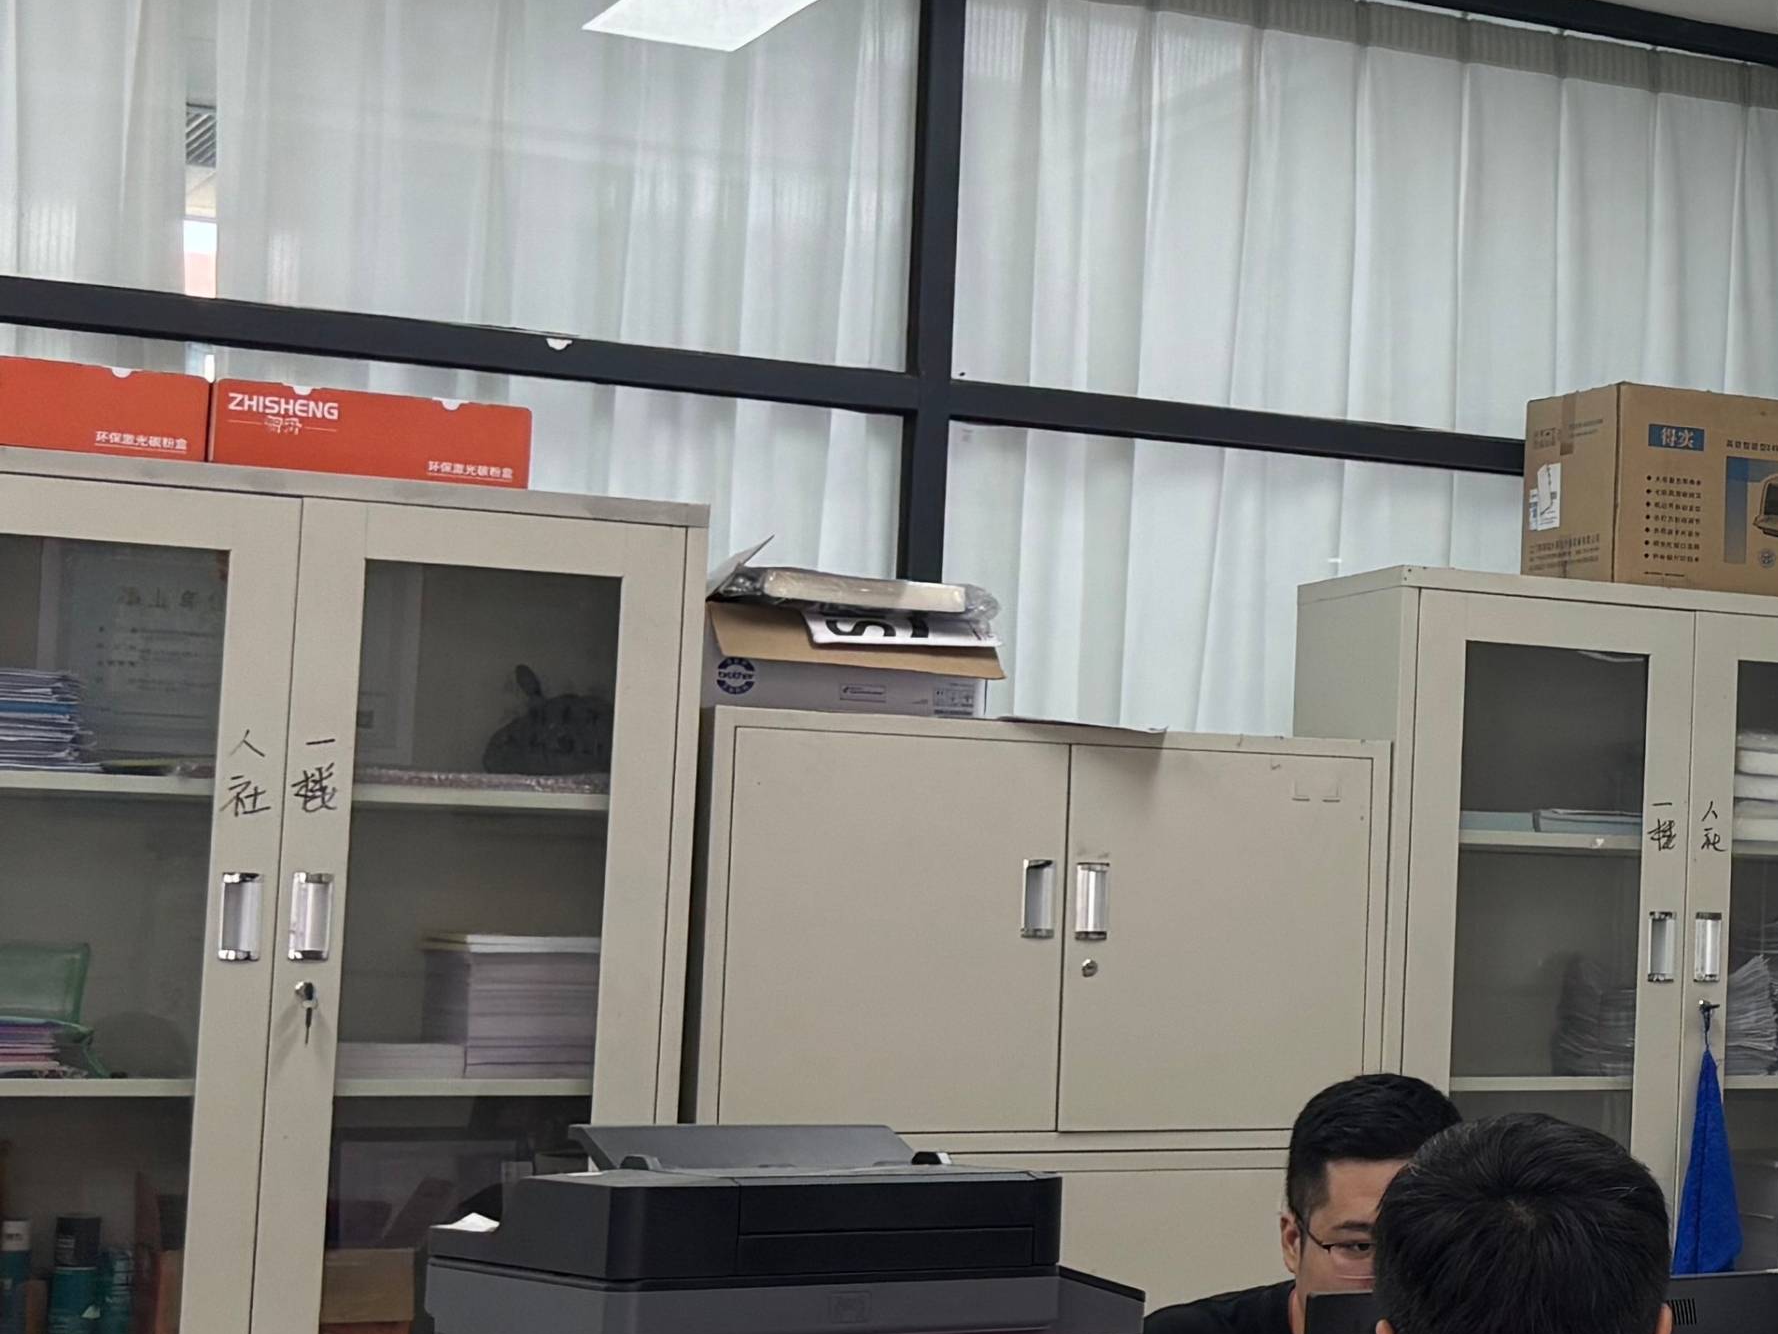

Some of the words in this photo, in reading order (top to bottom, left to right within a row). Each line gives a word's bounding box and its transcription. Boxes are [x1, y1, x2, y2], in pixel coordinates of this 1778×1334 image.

[228, 392, 339, 420] ZHISHENG
[1661, 426, 1694, 448] 得实
[221, 729, 272, 816] 人社
